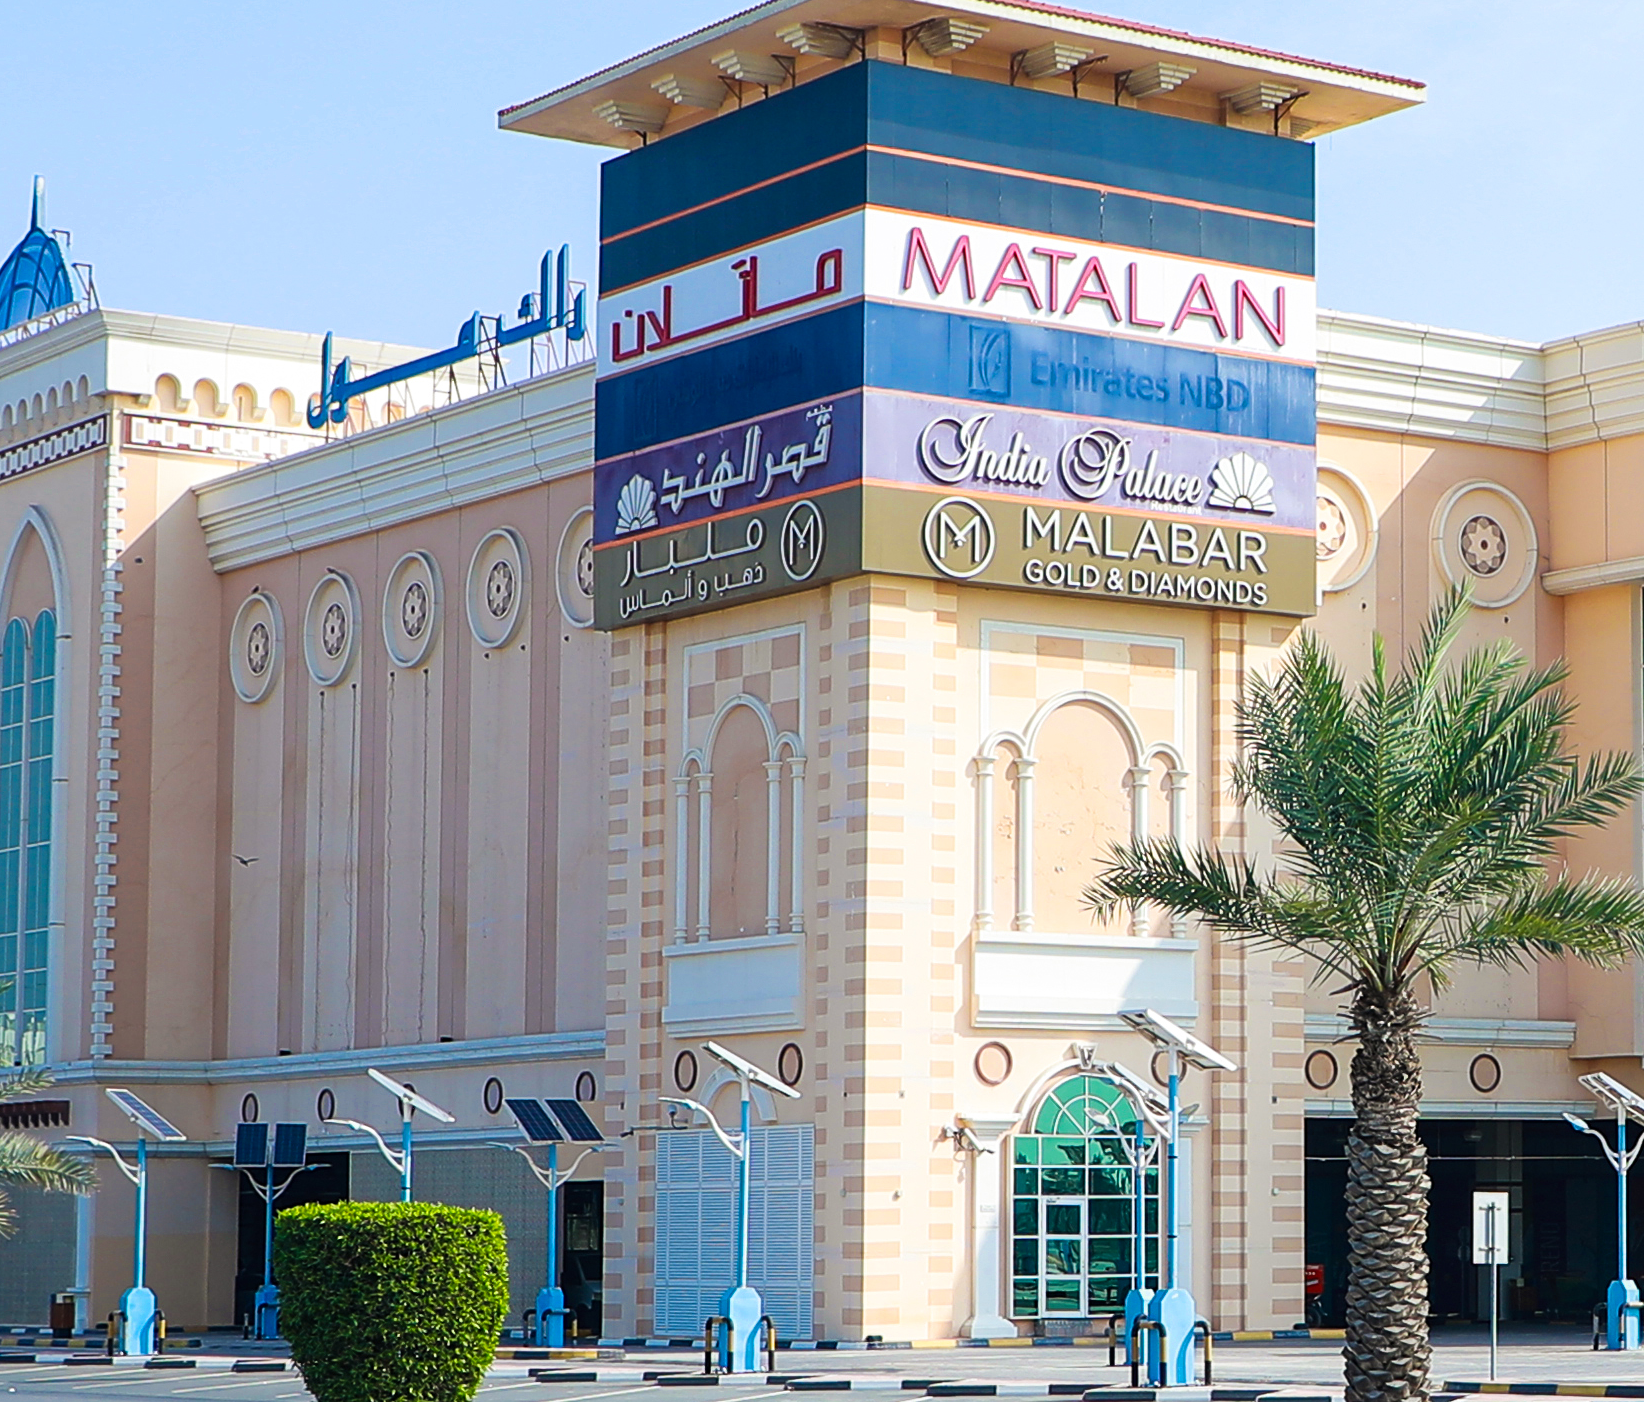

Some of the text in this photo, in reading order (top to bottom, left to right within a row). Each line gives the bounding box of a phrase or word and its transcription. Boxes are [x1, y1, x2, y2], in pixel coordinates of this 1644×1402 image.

[902, 226, 1287, 347] MATALAN
[1028, 349, 1251, 414] Emirates NBD
[660, 412, 834, 516] قصر الهند
[916, 412, 1204, 506] India Palace
[1023, 505, 1270, 575] MALABAR
[1150, 501, 1203, 517] Restaurant
[619, 517, 764, 588] ملبار
[713, 561, 764, 596] ذهب
[1024, 559, 1269, 607] GOLD & DIAMONDS
